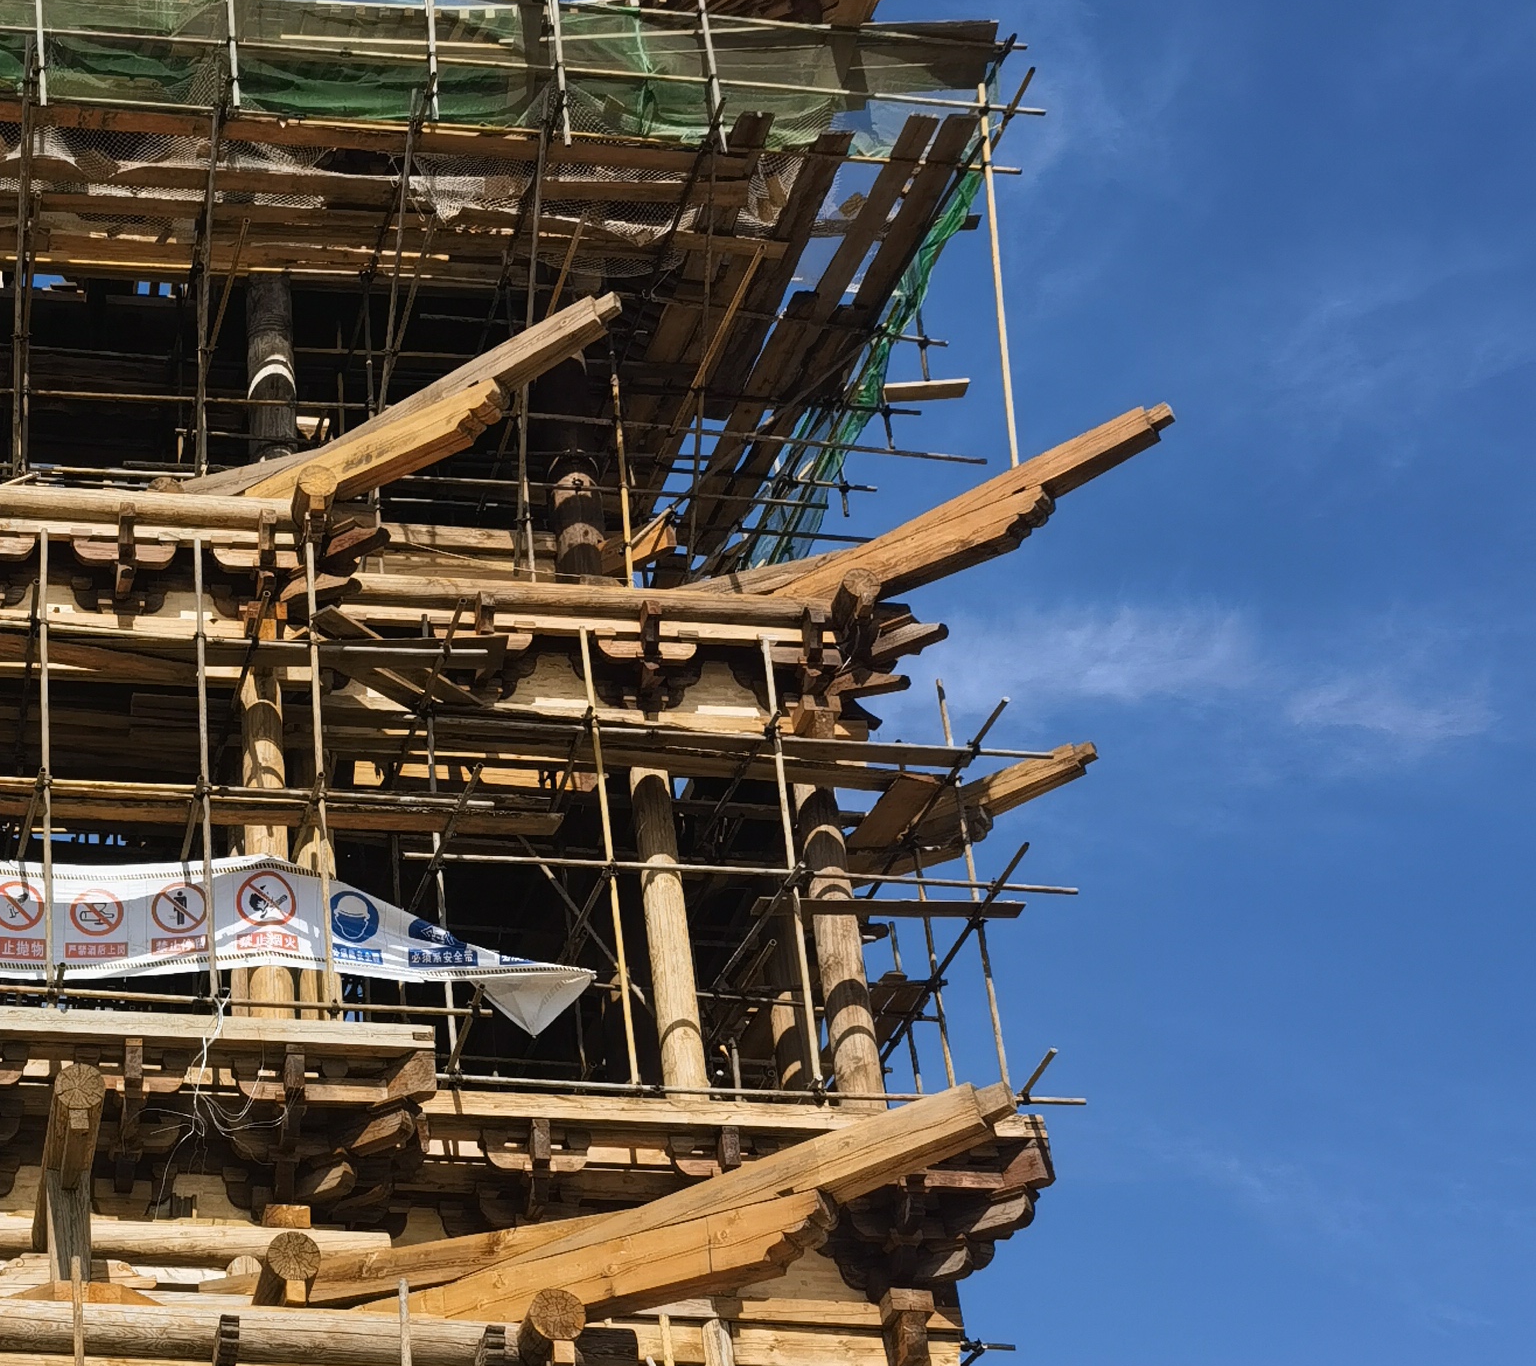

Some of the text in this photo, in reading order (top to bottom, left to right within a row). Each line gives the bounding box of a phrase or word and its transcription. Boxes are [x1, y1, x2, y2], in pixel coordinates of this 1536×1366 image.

[238, 931, 296, 949] 禁止烟火
[68, 944, 126, 956] 严禁酒后上岗
[411, 950, 474, 964] 必须系安全带
